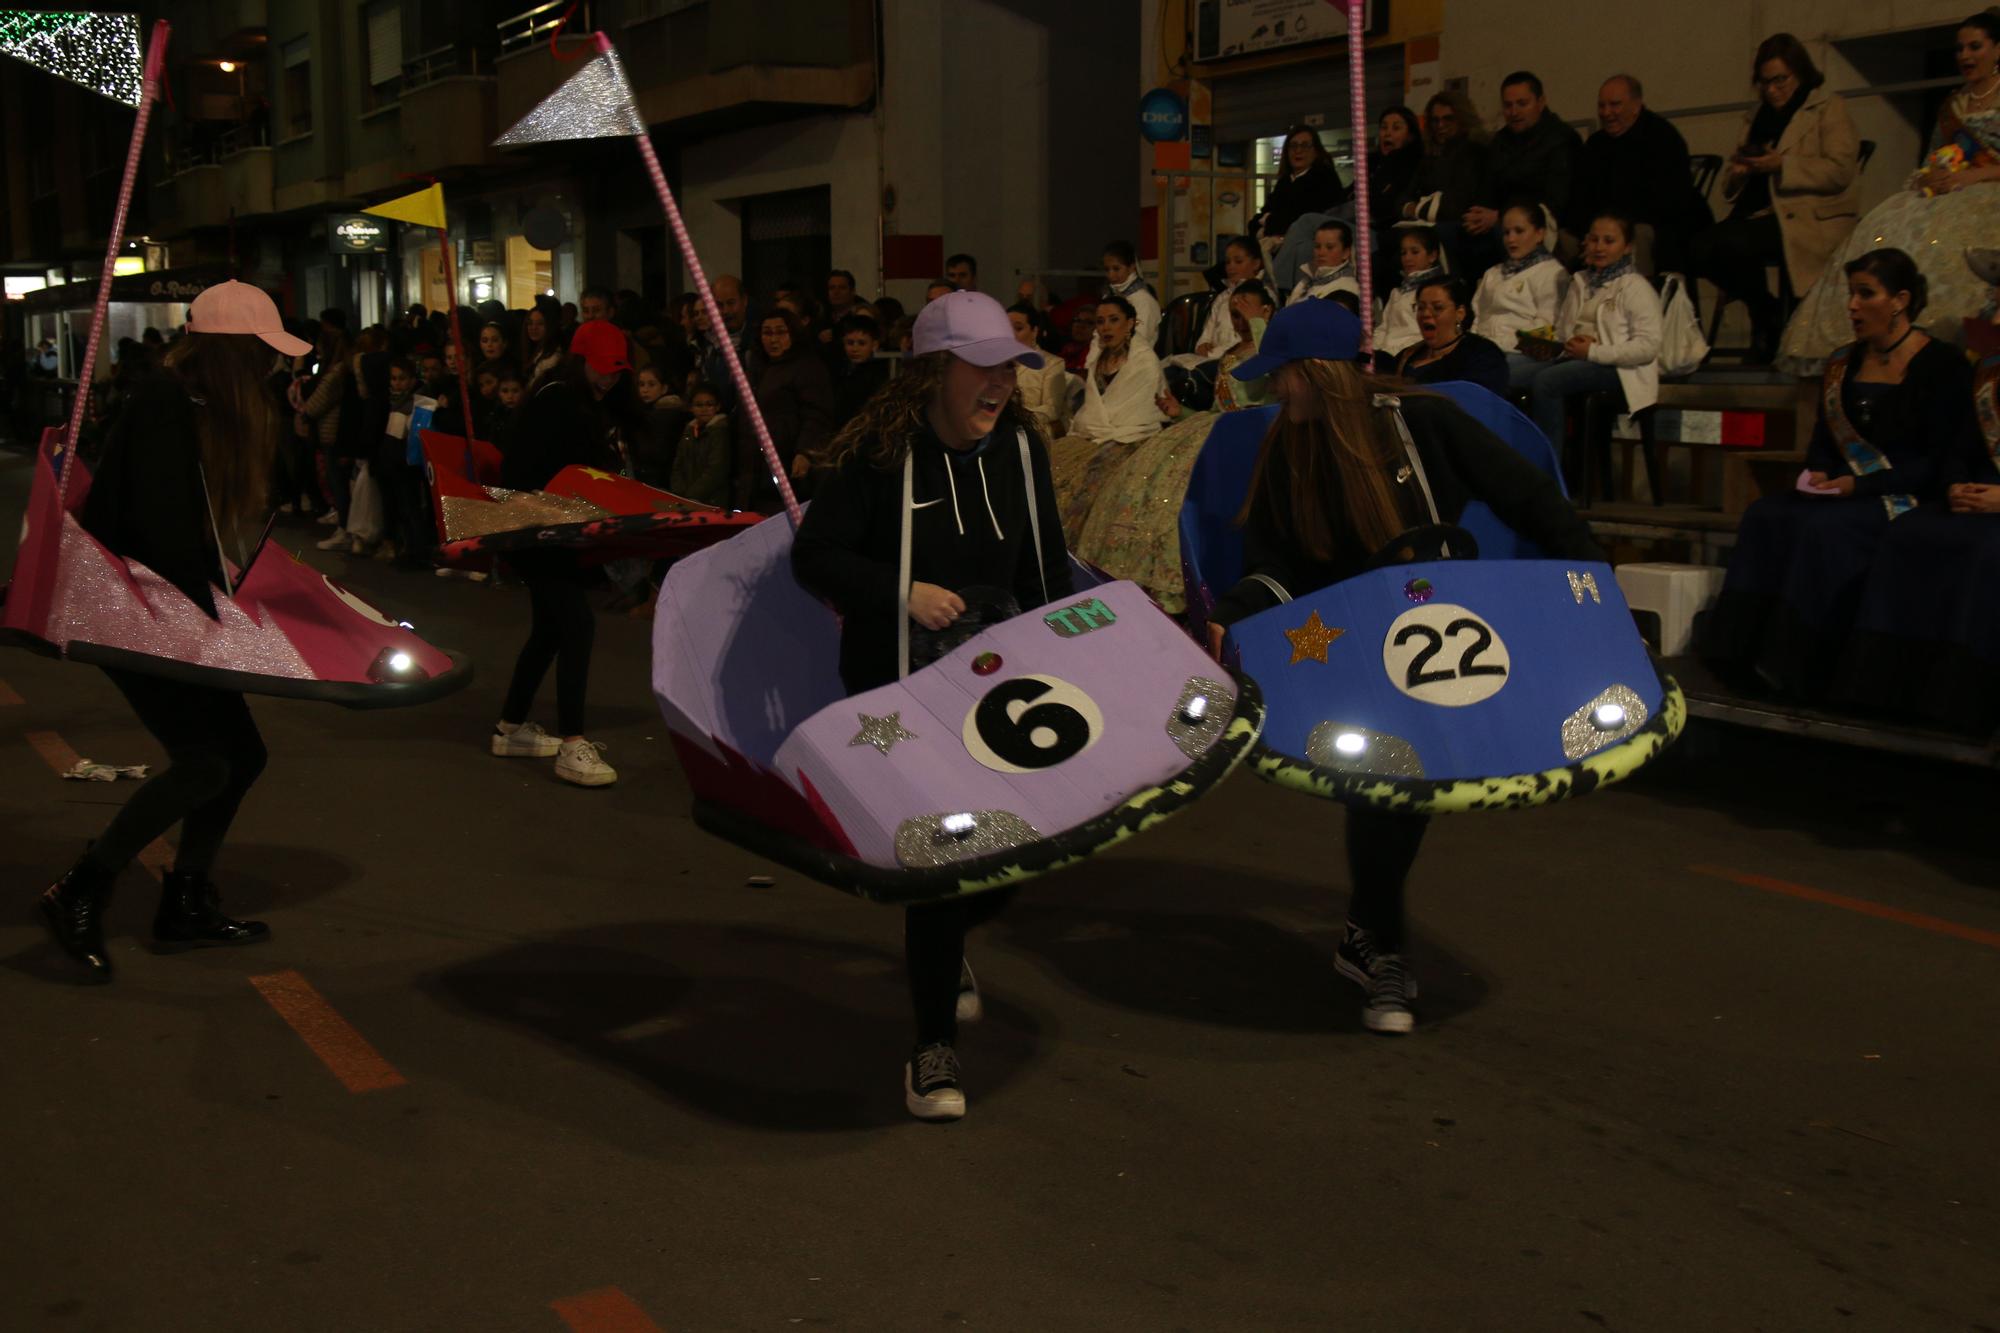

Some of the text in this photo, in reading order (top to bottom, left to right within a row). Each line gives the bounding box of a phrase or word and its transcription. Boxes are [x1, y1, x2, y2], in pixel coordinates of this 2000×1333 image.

[1142, 112, 1183, 123] DIGI
[1044, 598, 1117, 633] TM
[1393, 618, 1506, 689] 22
[975, 678, 1089, 768] 6
